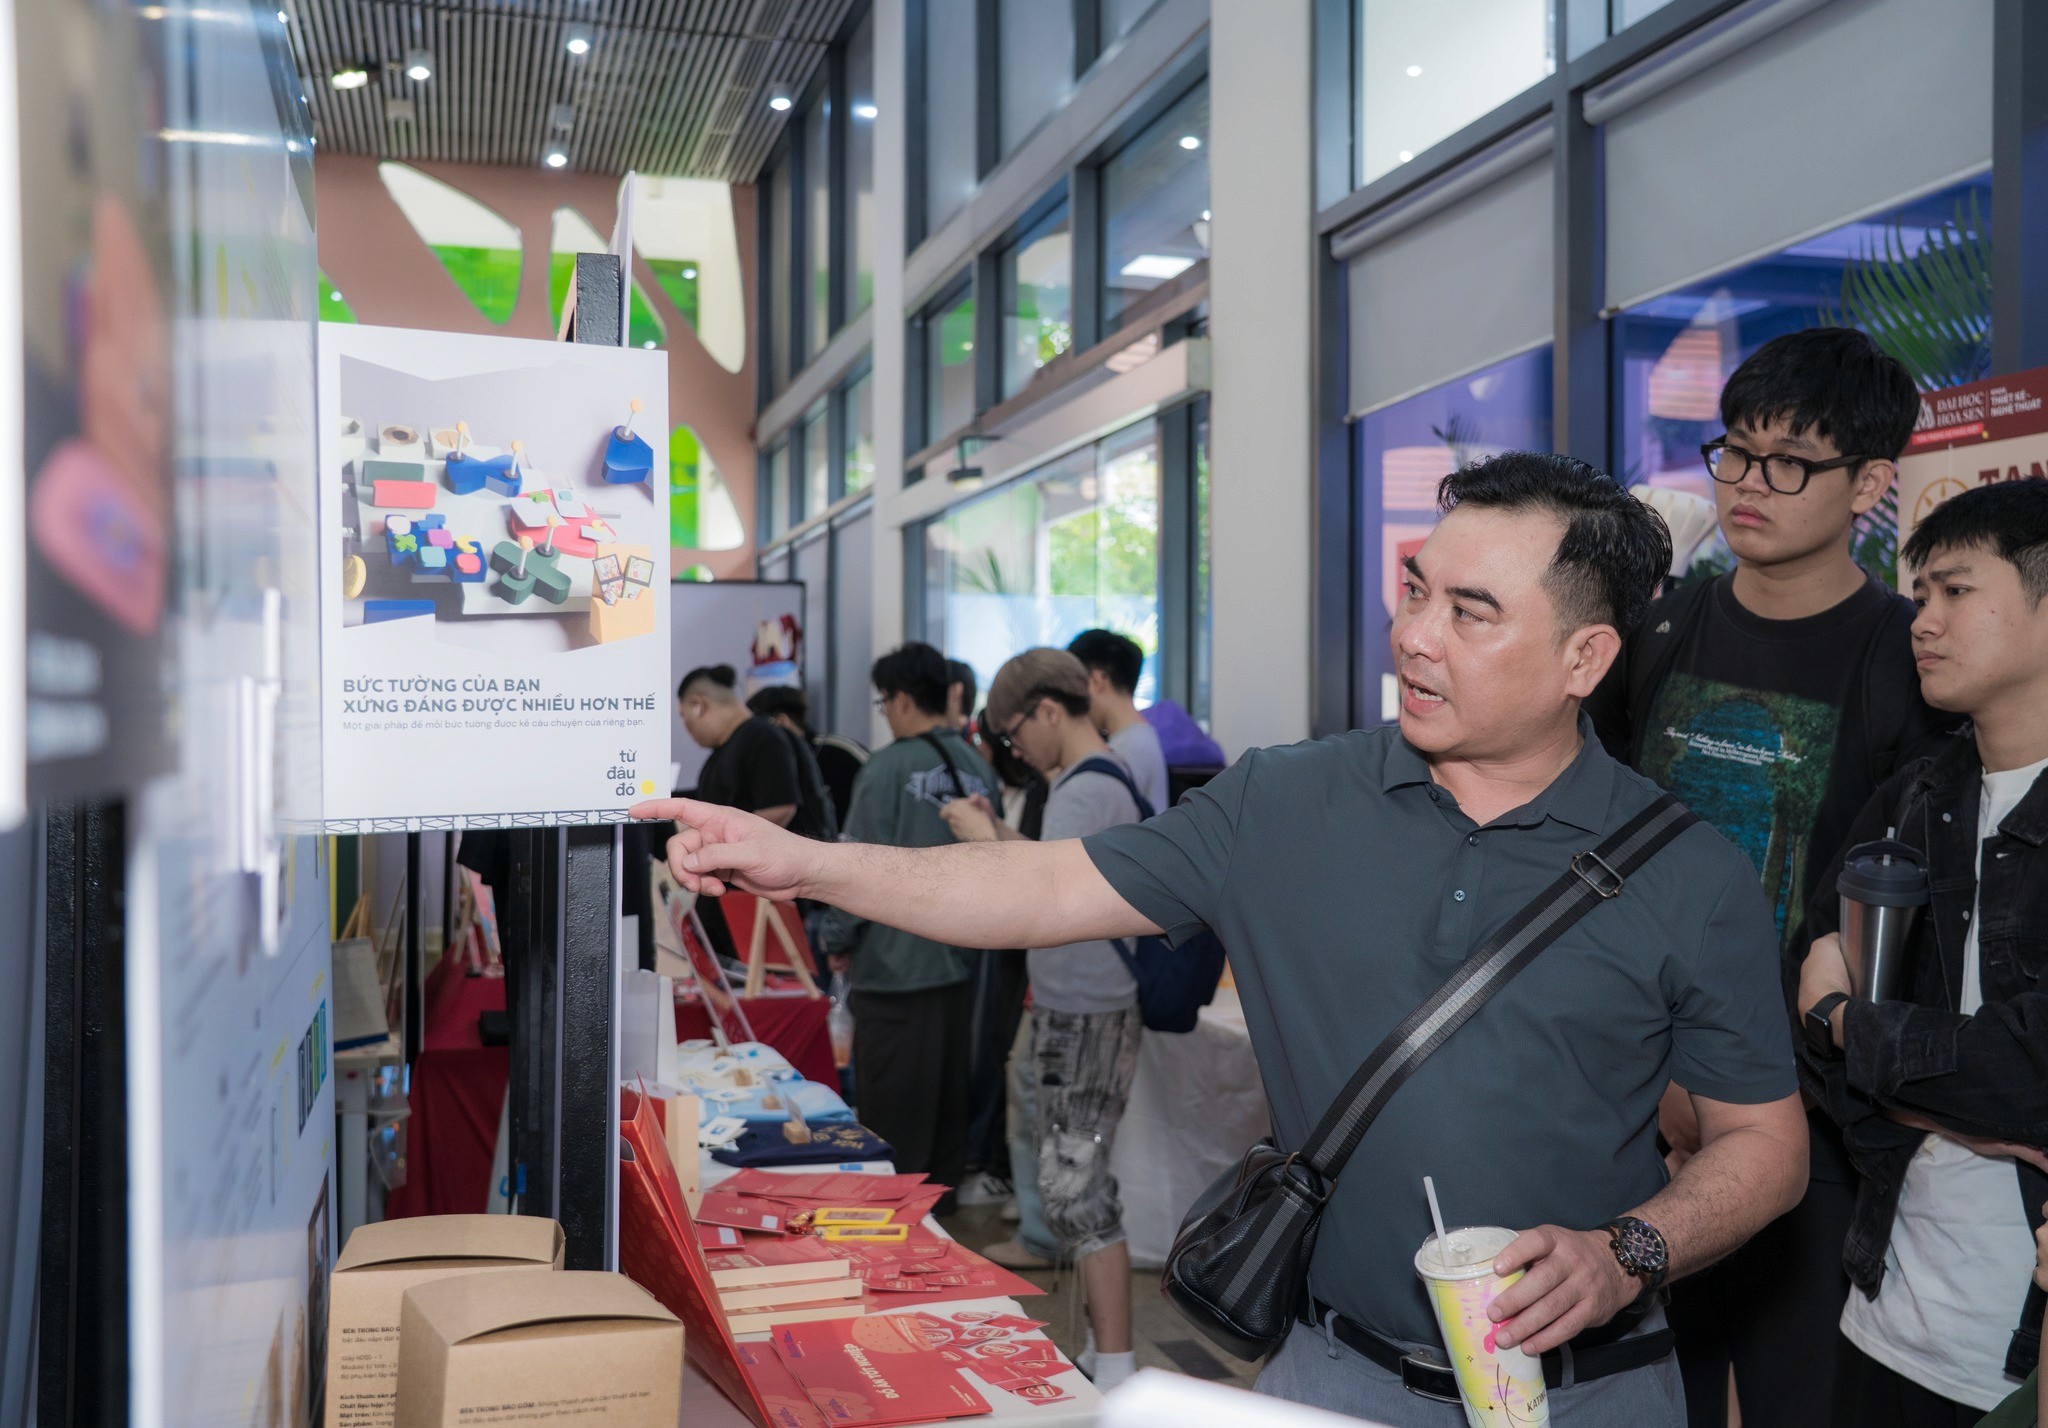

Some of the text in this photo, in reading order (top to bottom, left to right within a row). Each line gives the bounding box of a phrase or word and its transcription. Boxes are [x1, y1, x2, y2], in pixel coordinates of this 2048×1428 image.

[343, 674, 540, 695] BỨC TƯỜNG CỦA BẠN
[343, 692, 656, 716] XỨNG ĐÁNG ĐƯỢC NHIỀU HƠN THẾ
[619, 749, 637, 763] từ
[607, 766, 635, 780] đâu
[616, 782, 635, 796] đó
